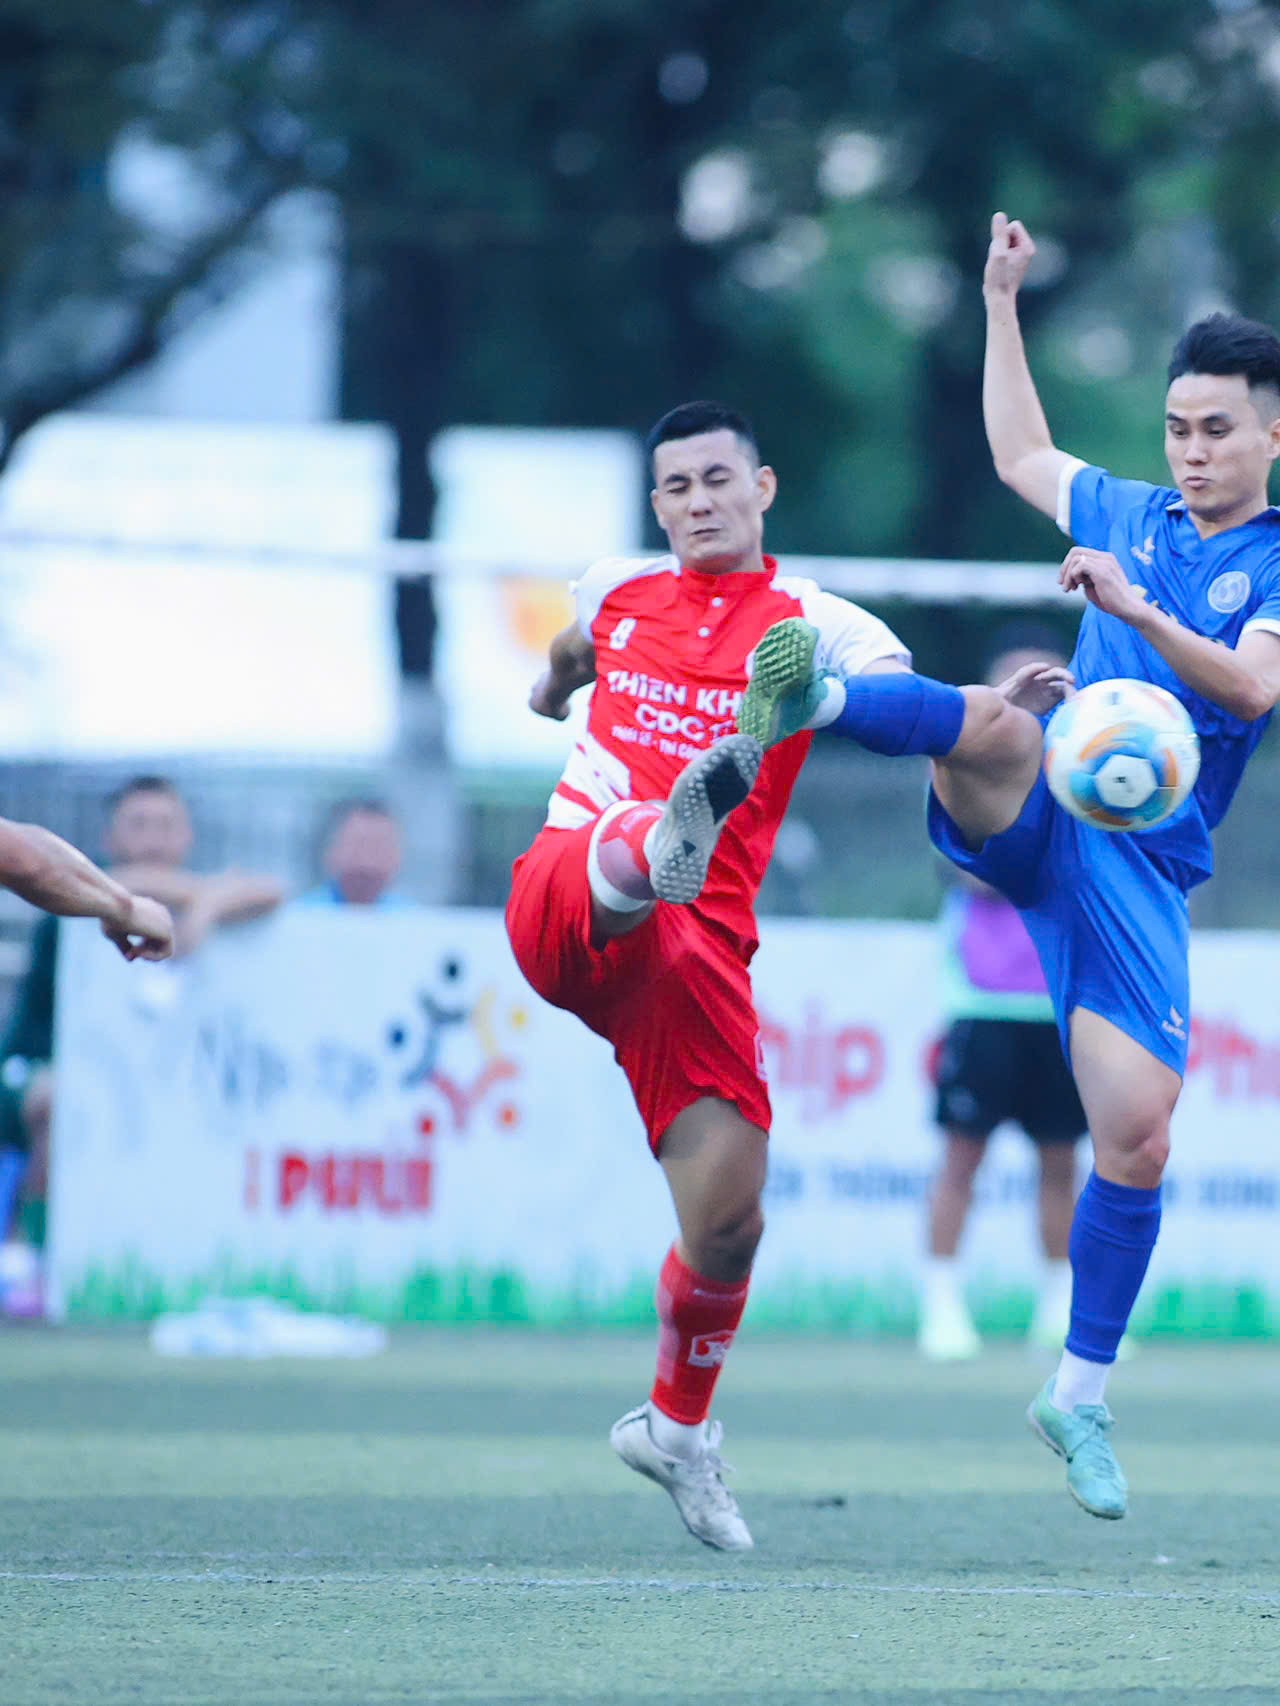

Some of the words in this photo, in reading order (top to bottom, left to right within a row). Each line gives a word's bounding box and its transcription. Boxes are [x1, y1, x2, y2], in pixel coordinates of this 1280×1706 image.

[611, 617, 637, 650] 8
[696, 688, 744, 718] KH
[634, 702, 705, 742] CDC
